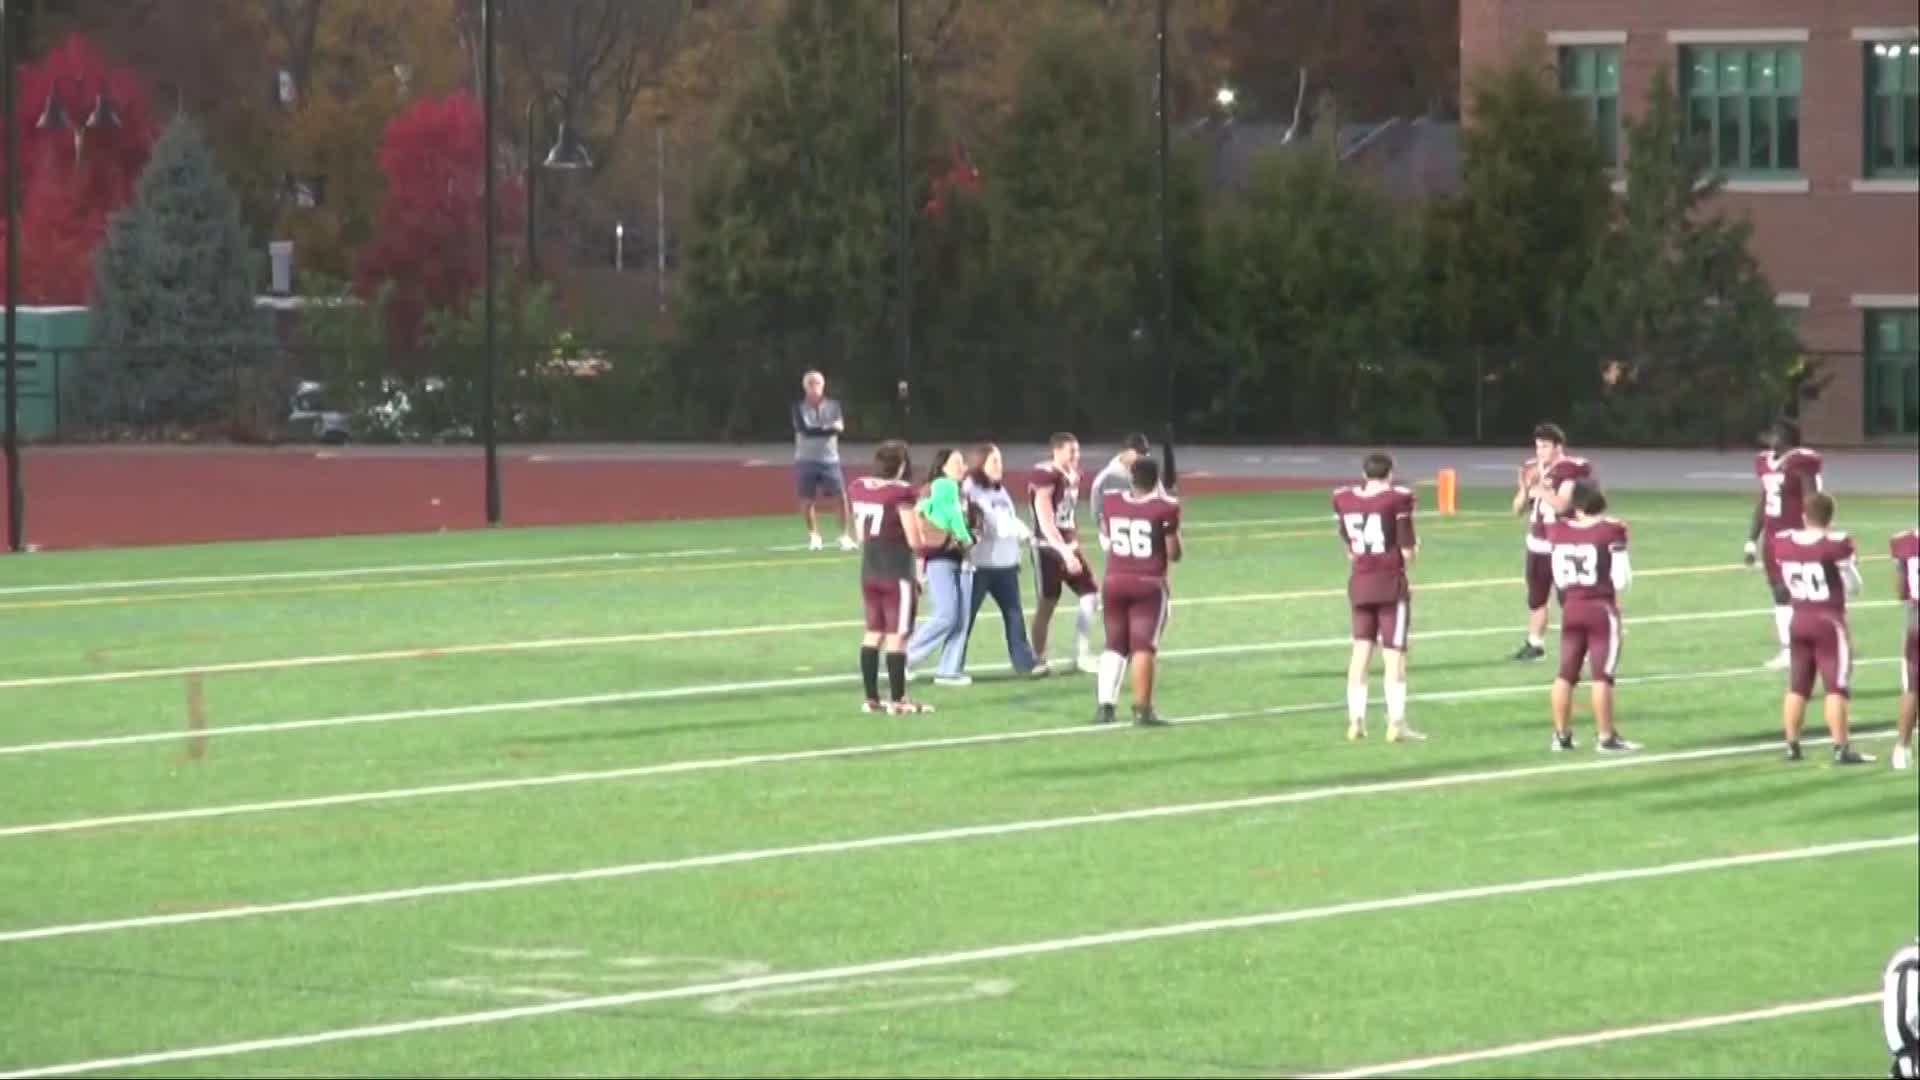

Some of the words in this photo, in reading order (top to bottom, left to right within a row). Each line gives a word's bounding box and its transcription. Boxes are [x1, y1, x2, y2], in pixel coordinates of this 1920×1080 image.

[1109, 513, 1152, 558] 56
[1343, 513, 1386, 553] 54
[1552, 543, 1598, 586] 63
